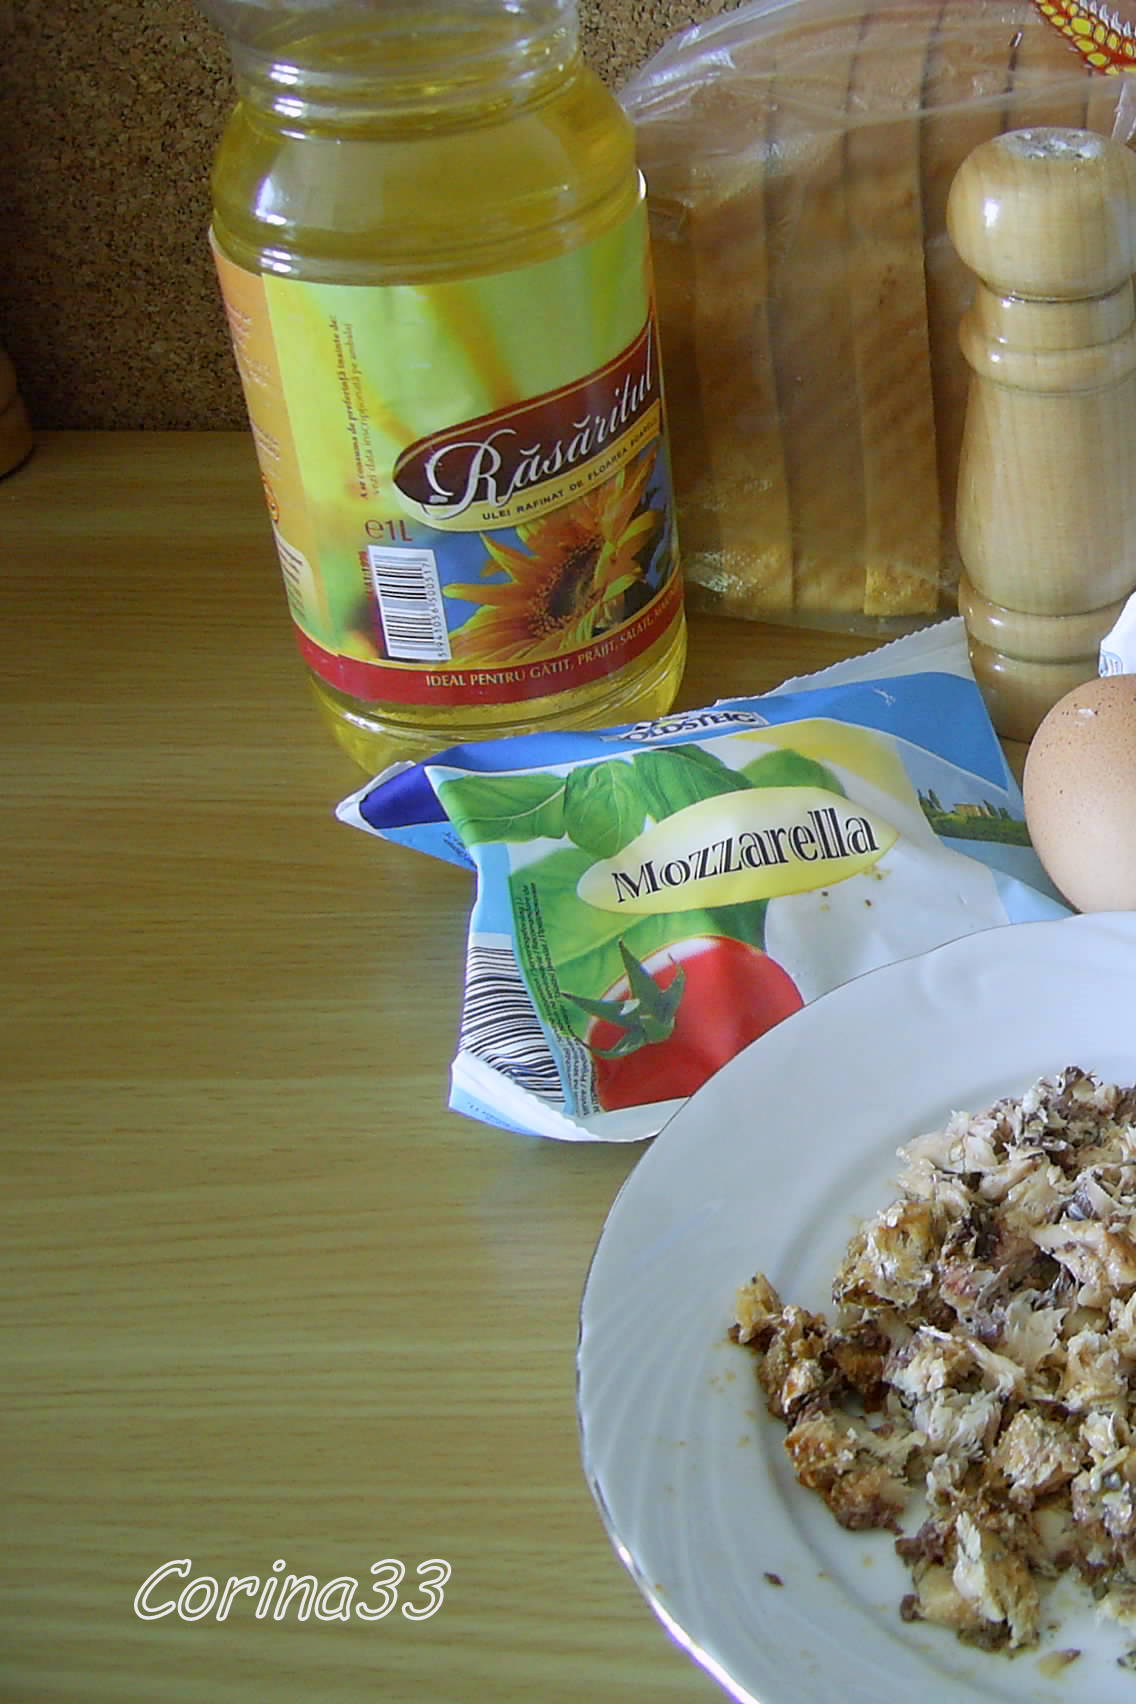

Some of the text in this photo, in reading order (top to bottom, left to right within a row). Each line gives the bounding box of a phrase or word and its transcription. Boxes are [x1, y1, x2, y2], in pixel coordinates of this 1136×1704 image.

[426, 320, 653, 521] Răsăritul
[482, 509, 512, 522] ULEI
[515, 489, 566, 515] RAFINAT
[568, 478, 585, 492] DE
[426, 675, 466, 688] IDEAL
[470, 670, 526, 687] PENTRU
[613, 806, 881, 904] Mozzarella
